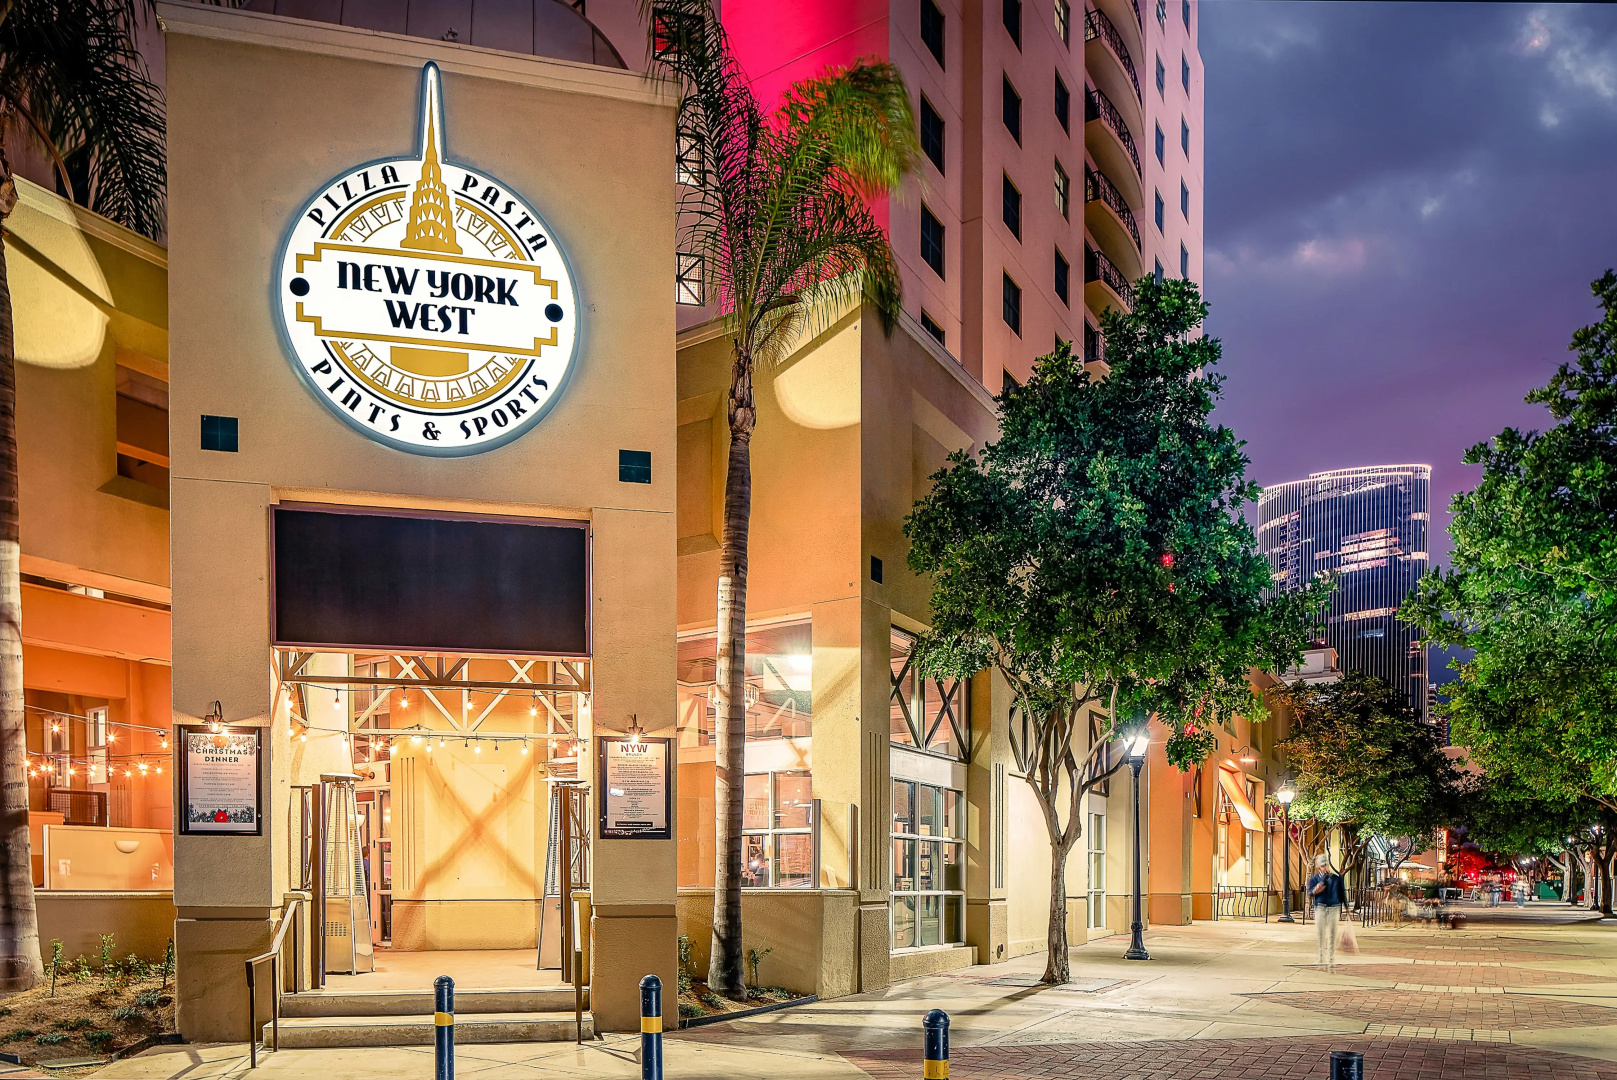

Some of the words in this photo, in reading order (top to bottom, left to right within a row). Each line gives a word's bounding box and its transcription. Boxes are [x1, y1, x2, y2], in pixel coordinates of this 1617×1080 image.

[307, 165, 400, 227] PIZZA
[461, 174, 548, 252] PASTA
[337, 261, 420, 295] NEW
[426, 269, 519, 306] YORK
[384, 299, 475, 335] WEST
[311, 359, 401, 432] PINTS
[422, 421, 442, 440] &
[459, 374, 548, 439] SPORTS
[620, 744, 648, 753] NYW
